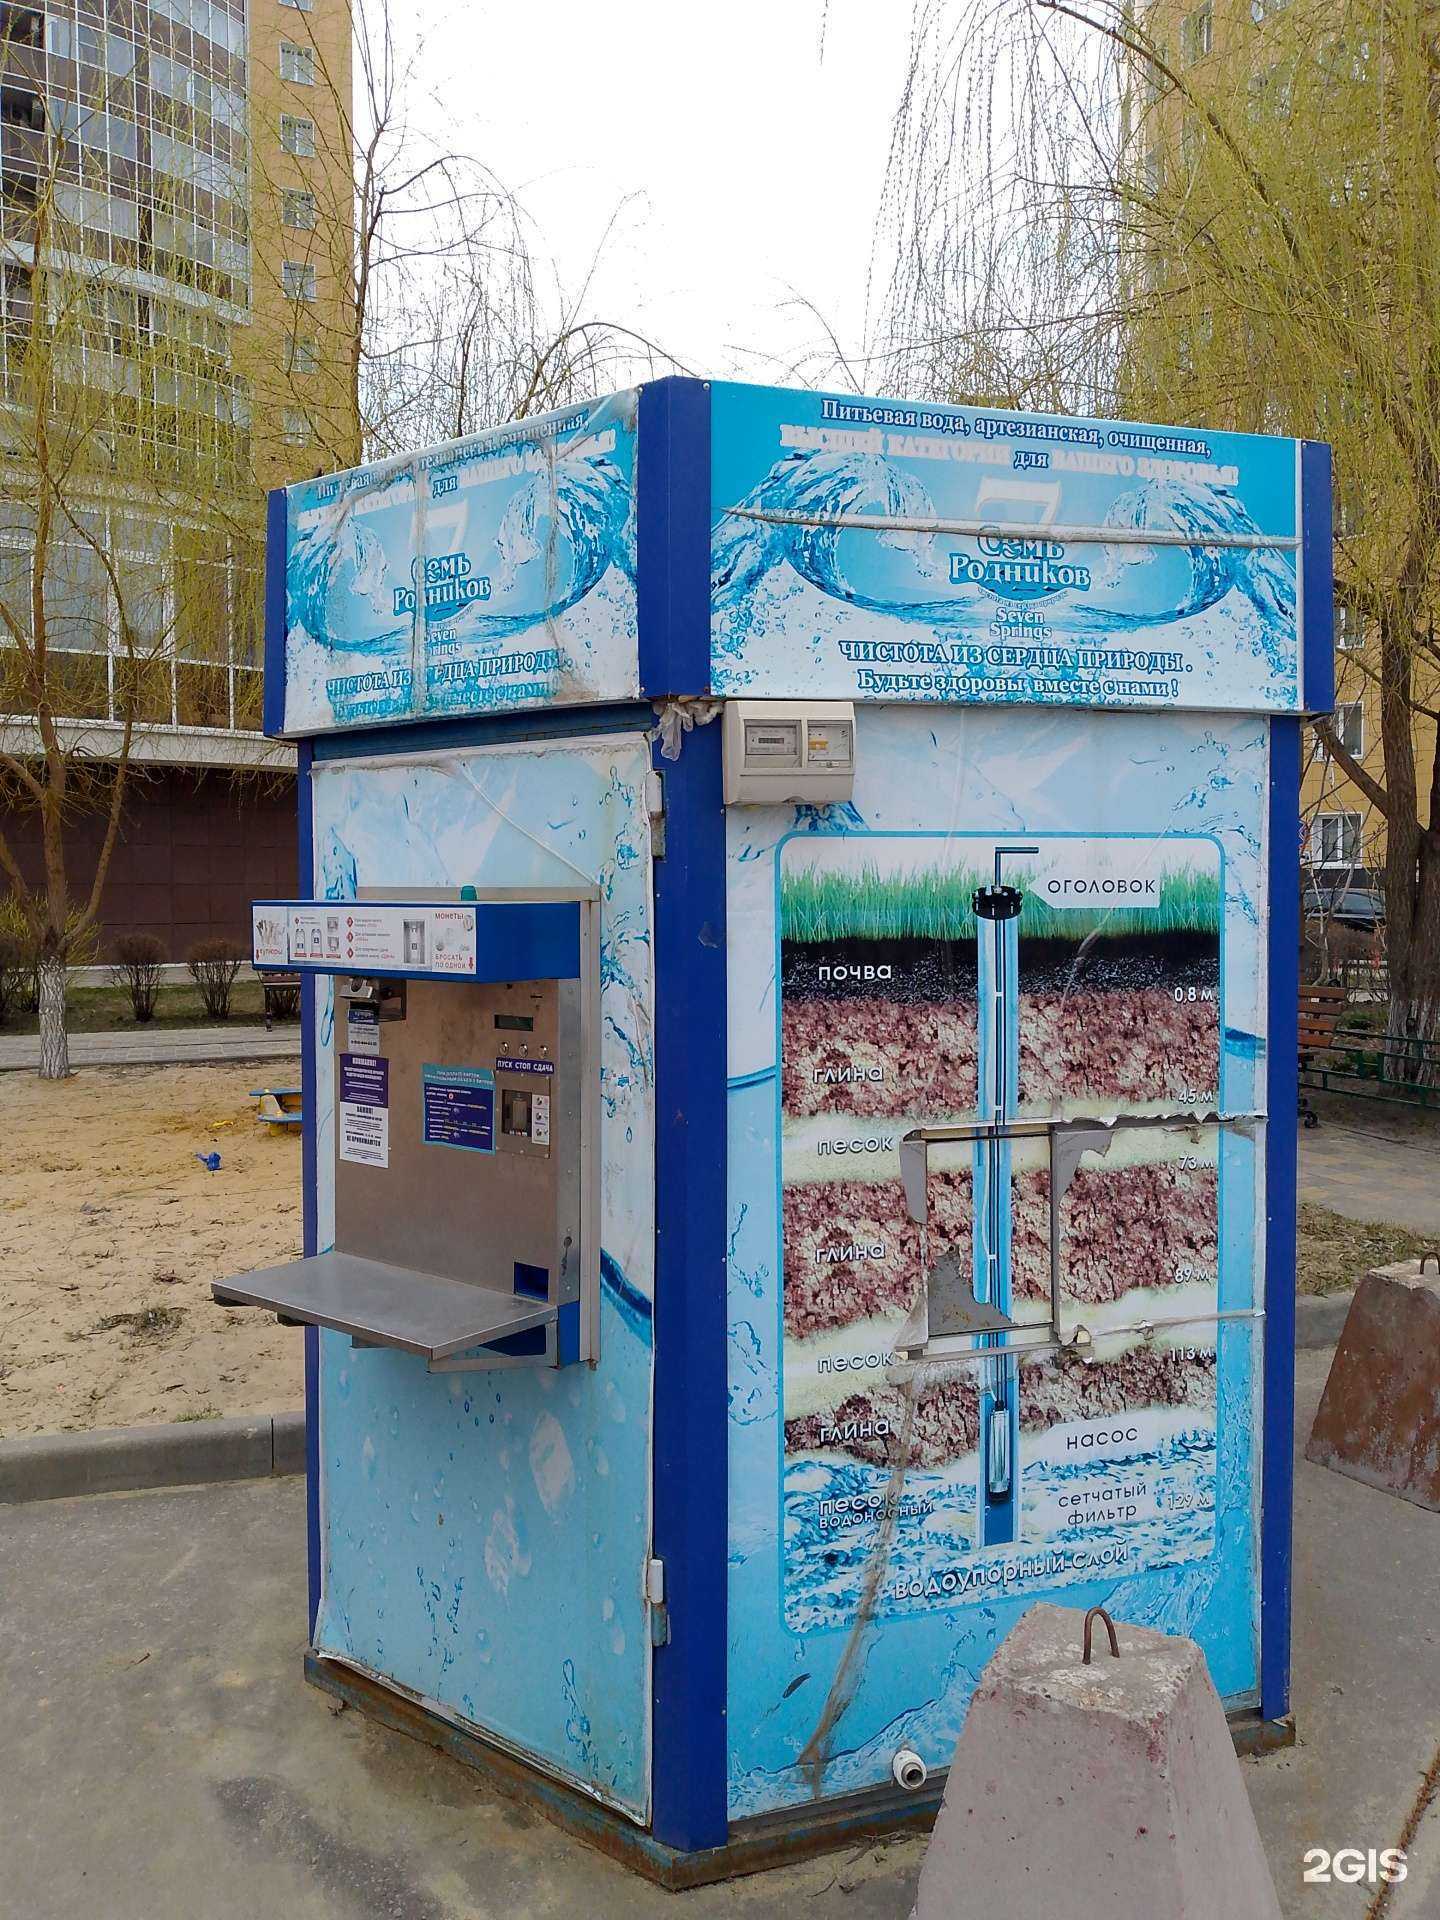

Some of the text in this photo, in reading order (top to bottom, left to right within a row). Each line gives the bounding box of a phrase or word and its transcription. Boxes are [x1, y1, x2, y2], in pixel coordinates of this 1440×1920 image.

[821, 399, 1211, 458] Питьевая вода, артезианская, очищенная,
[1013, 450, 1048, 470] для
[432, 475, 457, 498] для
[950, 553, 1090, 586] Родников
[394, 577, 491, 614] Роников
[995, 607, 1046, 624] Seven
[990, 622, 1052, 642] Springs
[839, 640, 949, 663] ЧИСТОТА
[951, 645, 983, 665] ИЗ
[986, 646, 1073, 670] СЕРДЦА
[858, 669, 933, 694] Будьте
[935, 675, 1025, 695] здоровы
[1033, 678, 1100, 695] вместе
[1103, 681, 1117, 695] с
[1047, 878, 1157, 895] оголовок
[818, 963, 892, 981] почва
[1174, 986, 1214, 1004] 0,8 м
[497, 1060, 553, 1072] ПУСК СТОП СДАЧА
[812, 1065, 884, 1083] глина
[1178, 1088, 1213, 1104] 45 м
[817, 1136, 894, 1155] песок
[1179, 1154, 1213, 1171] 73 м
[814, 1243, 885, 1263] глина
[1175, 1267, 1192, 1284] 89
[818, 1352, 895, 1373] песок
[1170, 1346, 1196, 1362] 113
[820, 1420, 890, 1443] глина
[1066, 1427, 1138, 1450] насос
[1058, 1482, 1147, 1508] сетчатый
[1067, 1505, 1137, 1529] фильтр
[895, 1538, 1128, 1600] водоупорный слой
